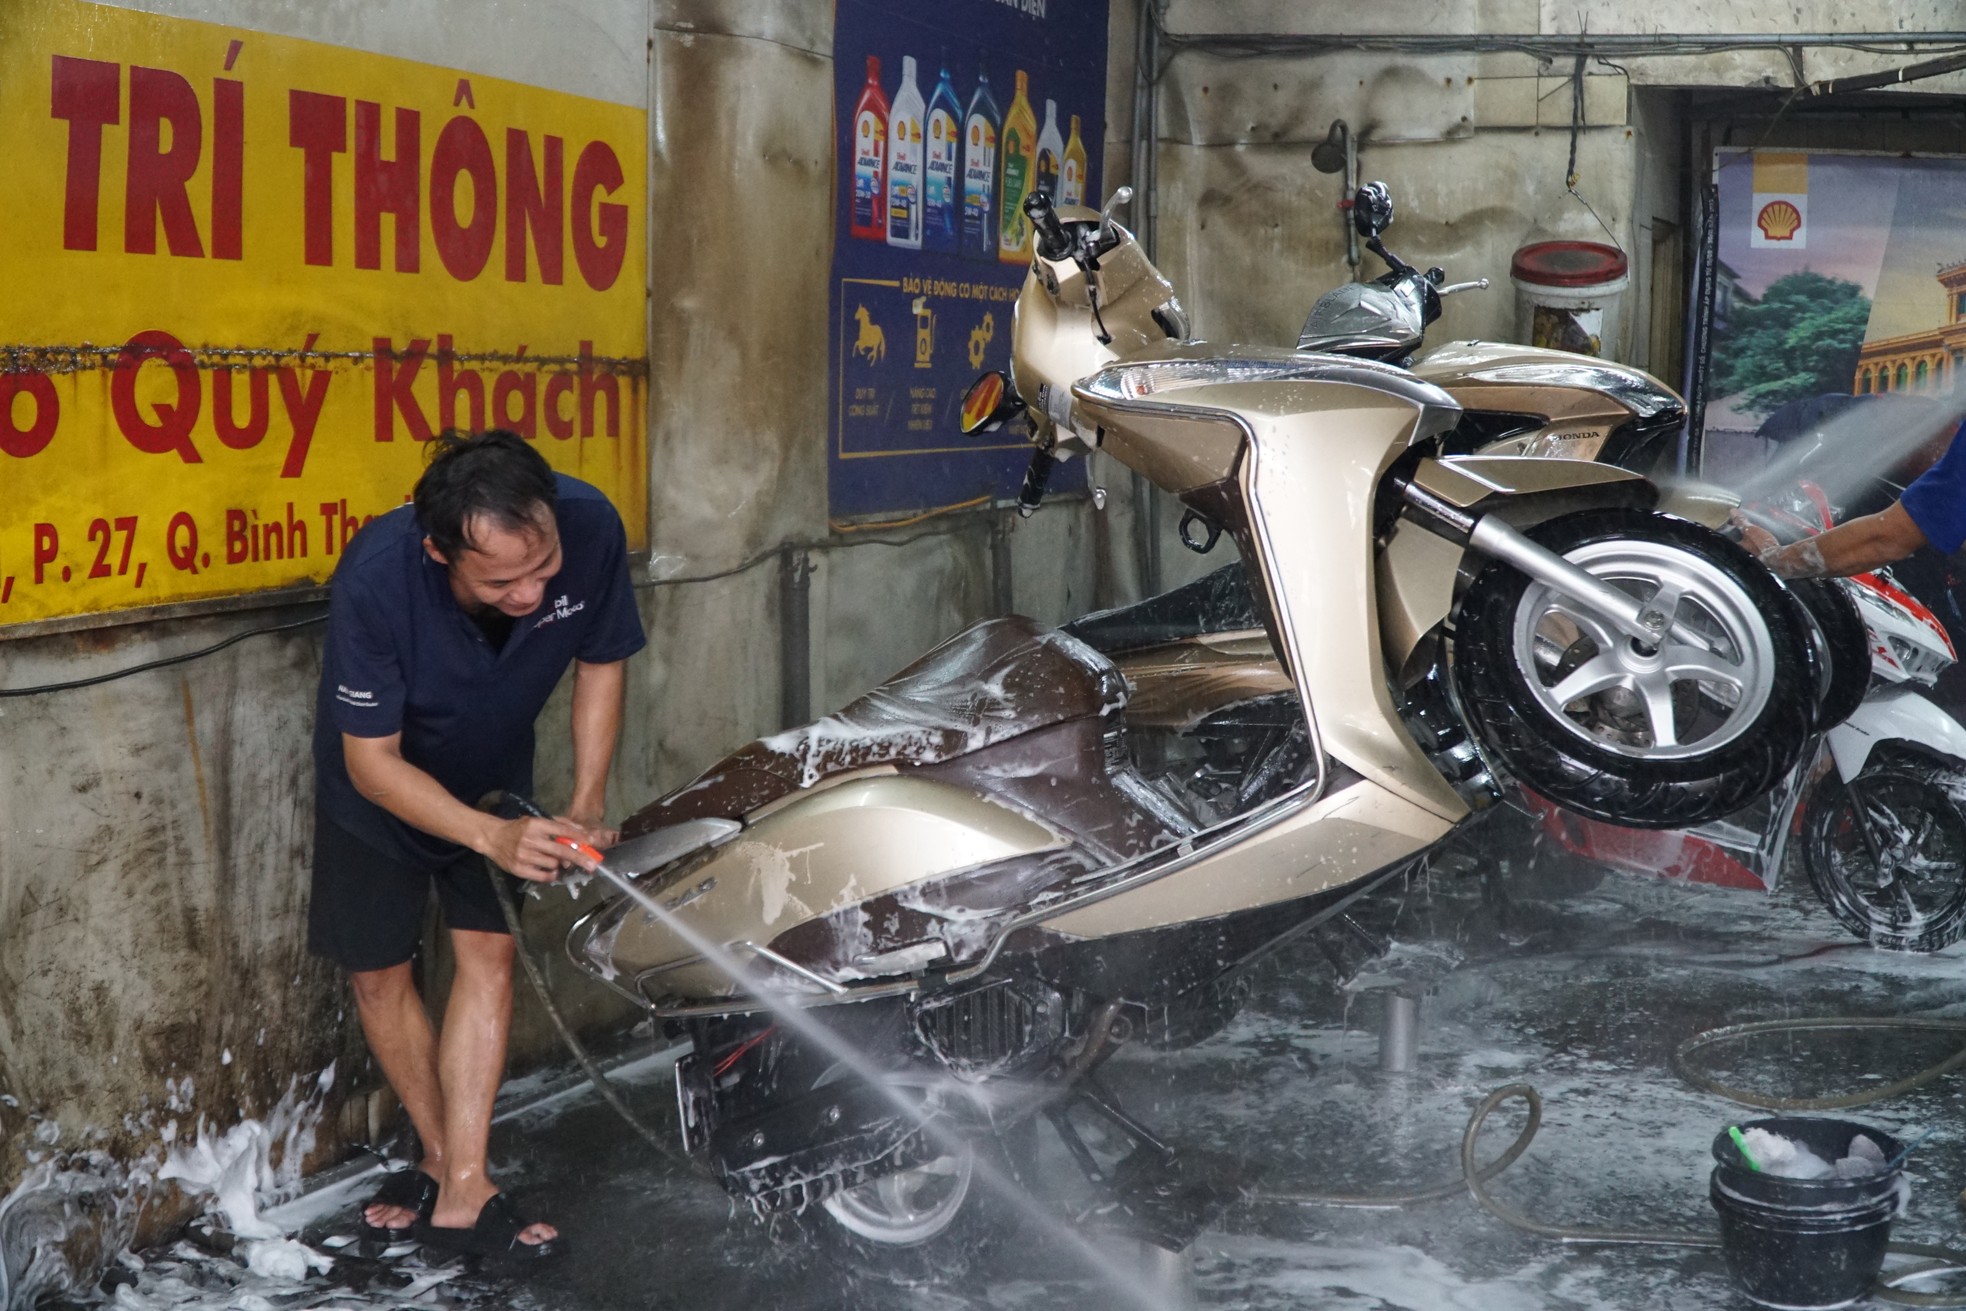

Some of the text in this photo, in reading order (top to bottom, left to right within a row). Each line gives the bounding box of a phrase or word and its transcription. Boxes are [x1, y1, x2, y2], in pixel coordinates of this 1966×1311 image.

[51, 40, 629, 292] TRÍ THÔNG
[111, 330, 333, 478] Quý
[372, 333, 621, 442] Khách
[34, 522, 72, 584] P.
[87, 516, 147, 588] 27,
[166, 511, 210, 575] Q.
[226, 502, 307, 565] Bình
